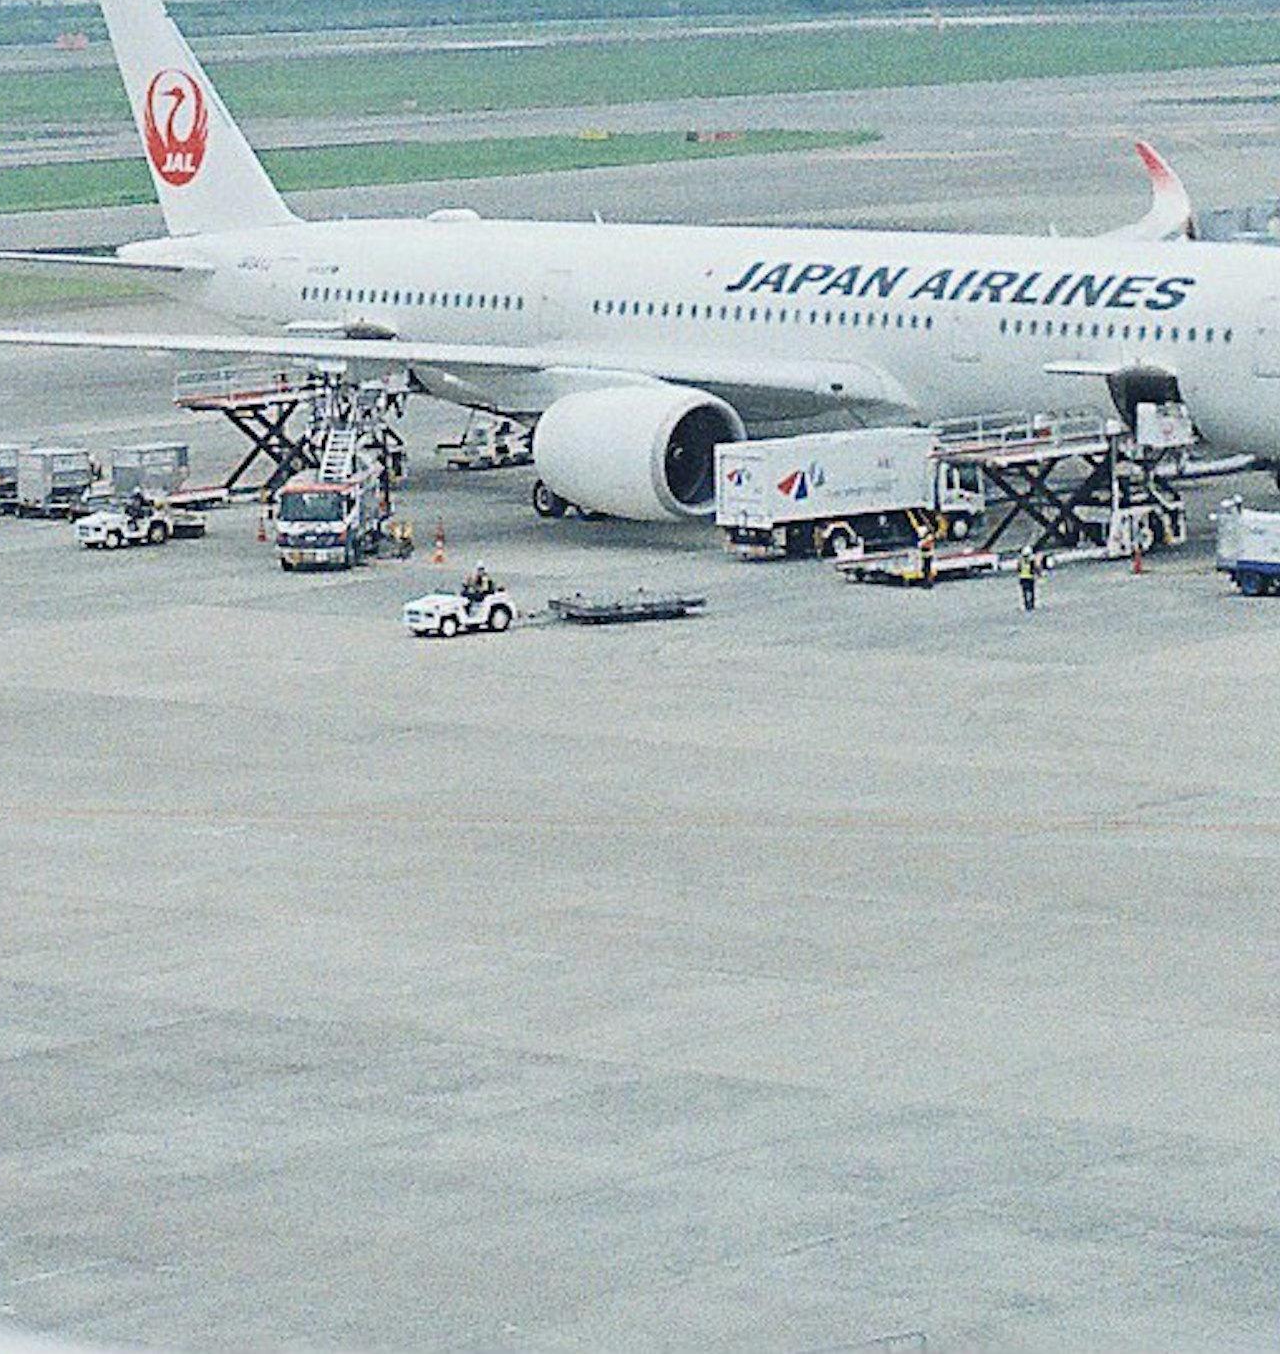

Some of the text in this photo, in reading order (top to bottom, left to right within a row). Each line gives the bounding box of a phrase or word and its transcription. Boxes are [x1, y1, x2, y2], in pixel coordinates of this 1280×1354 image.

[162, 152, 195, 173] JAL
[724, 261, 1196, 311] JAPAN AIRLINES
